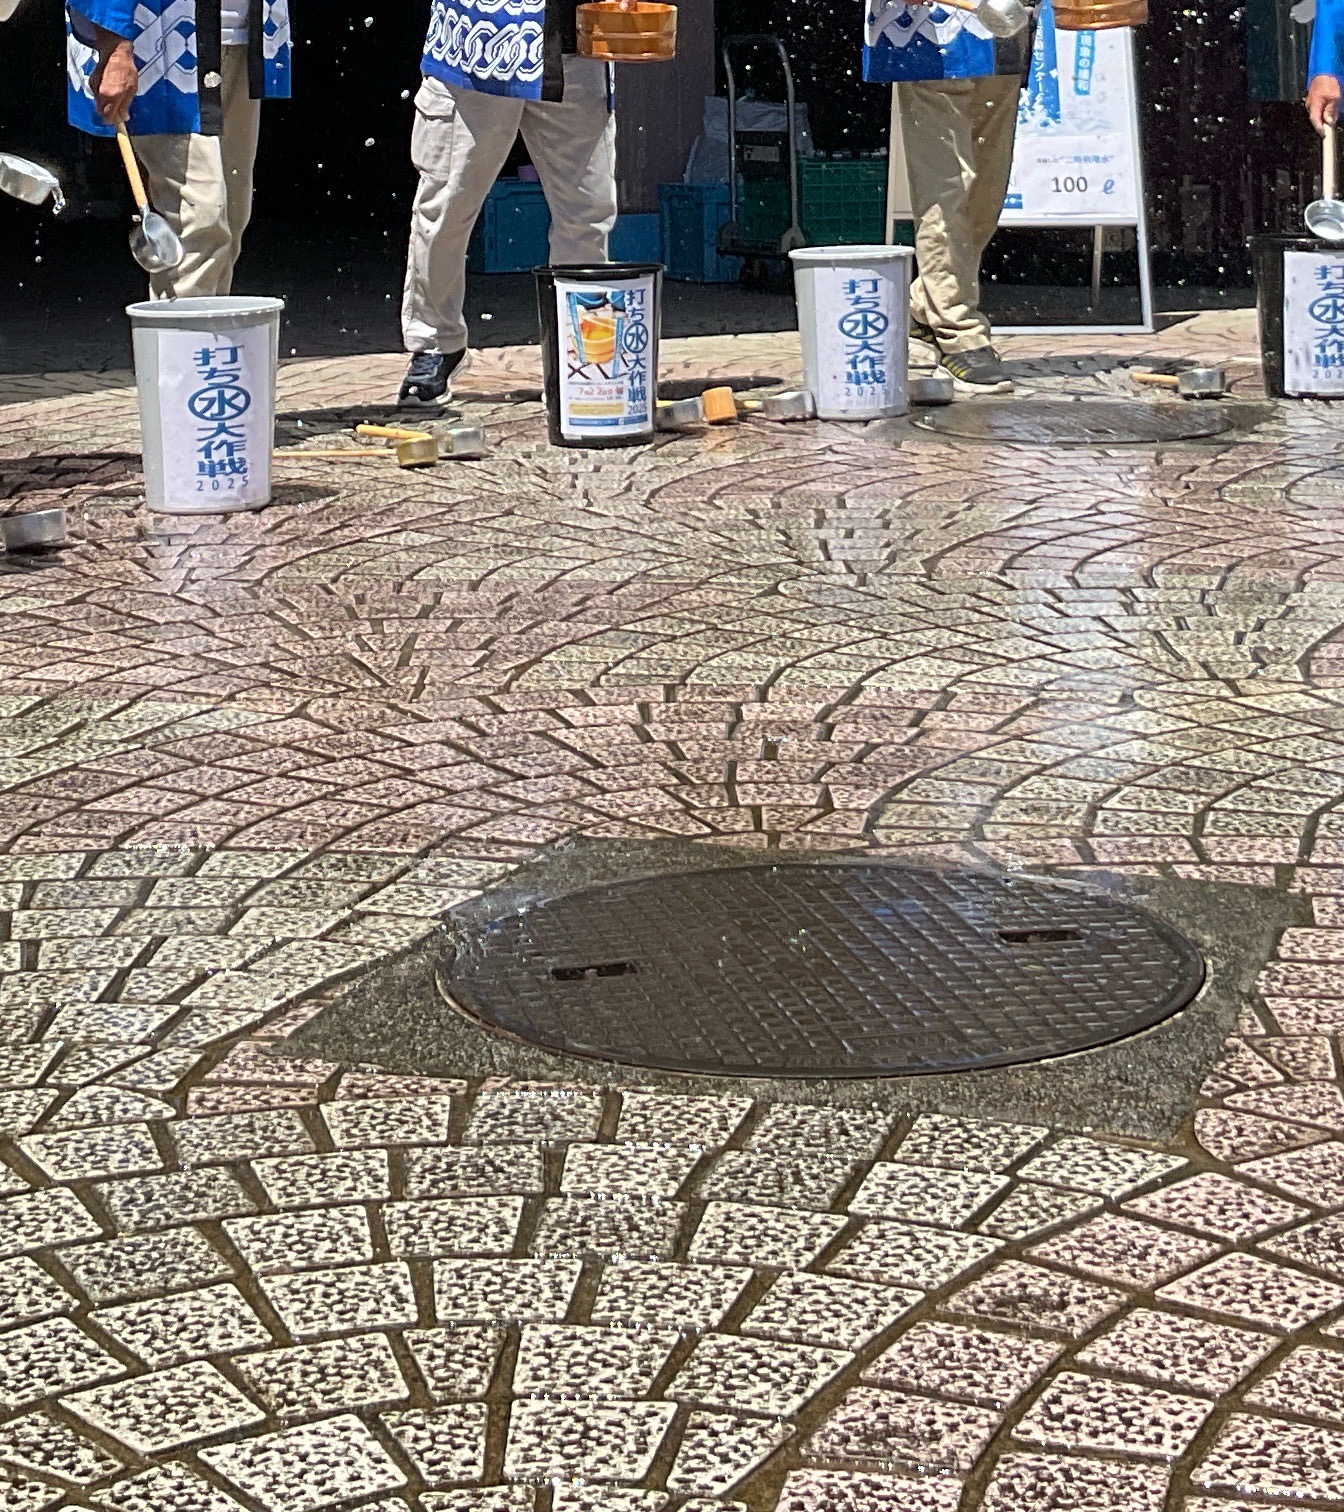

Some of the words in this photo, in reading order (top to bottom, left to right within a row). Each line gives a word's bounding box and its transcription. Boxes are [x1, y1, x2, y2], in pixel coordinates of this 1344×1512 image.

[1051, 176, 1088, 193] 100
[838, 277, 889, 385] 打ち水大作戦
[188, 345, 252, 478] 打ち水大作戦
[195, 475, 250, 492] 2025
